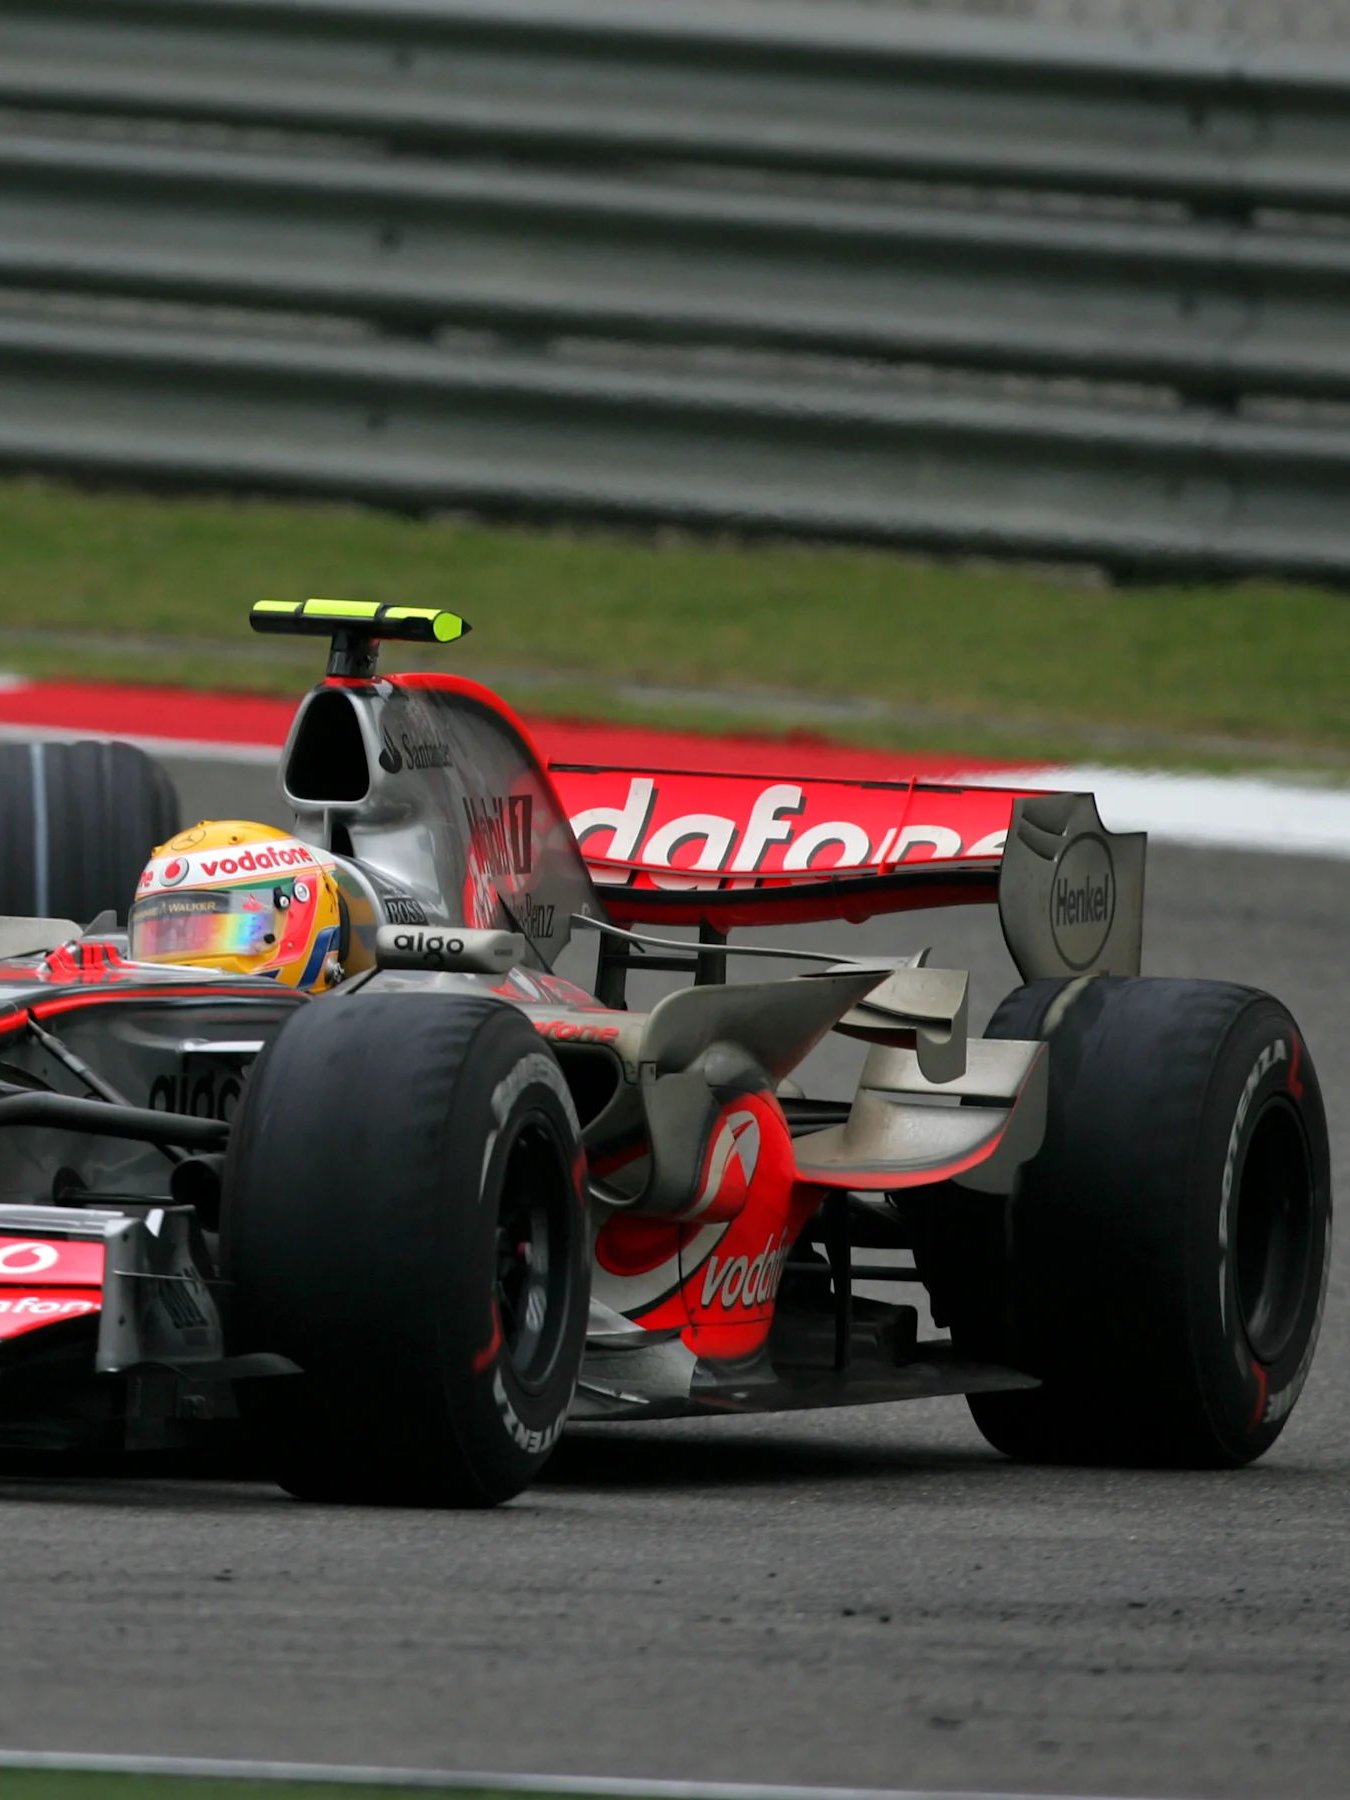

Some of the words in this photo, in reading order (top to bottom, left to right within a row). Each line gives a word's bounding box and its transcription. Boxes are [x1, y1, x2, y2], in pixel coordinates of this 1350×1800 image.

[201, 846, 313, 877] vodafone
[169, 902, 216, 913] WALKER
[1056, 873, 1109, 926] Henkel
[388, 901, 424, 924] BOSS
[534, 1020, 620, 1042] afone
